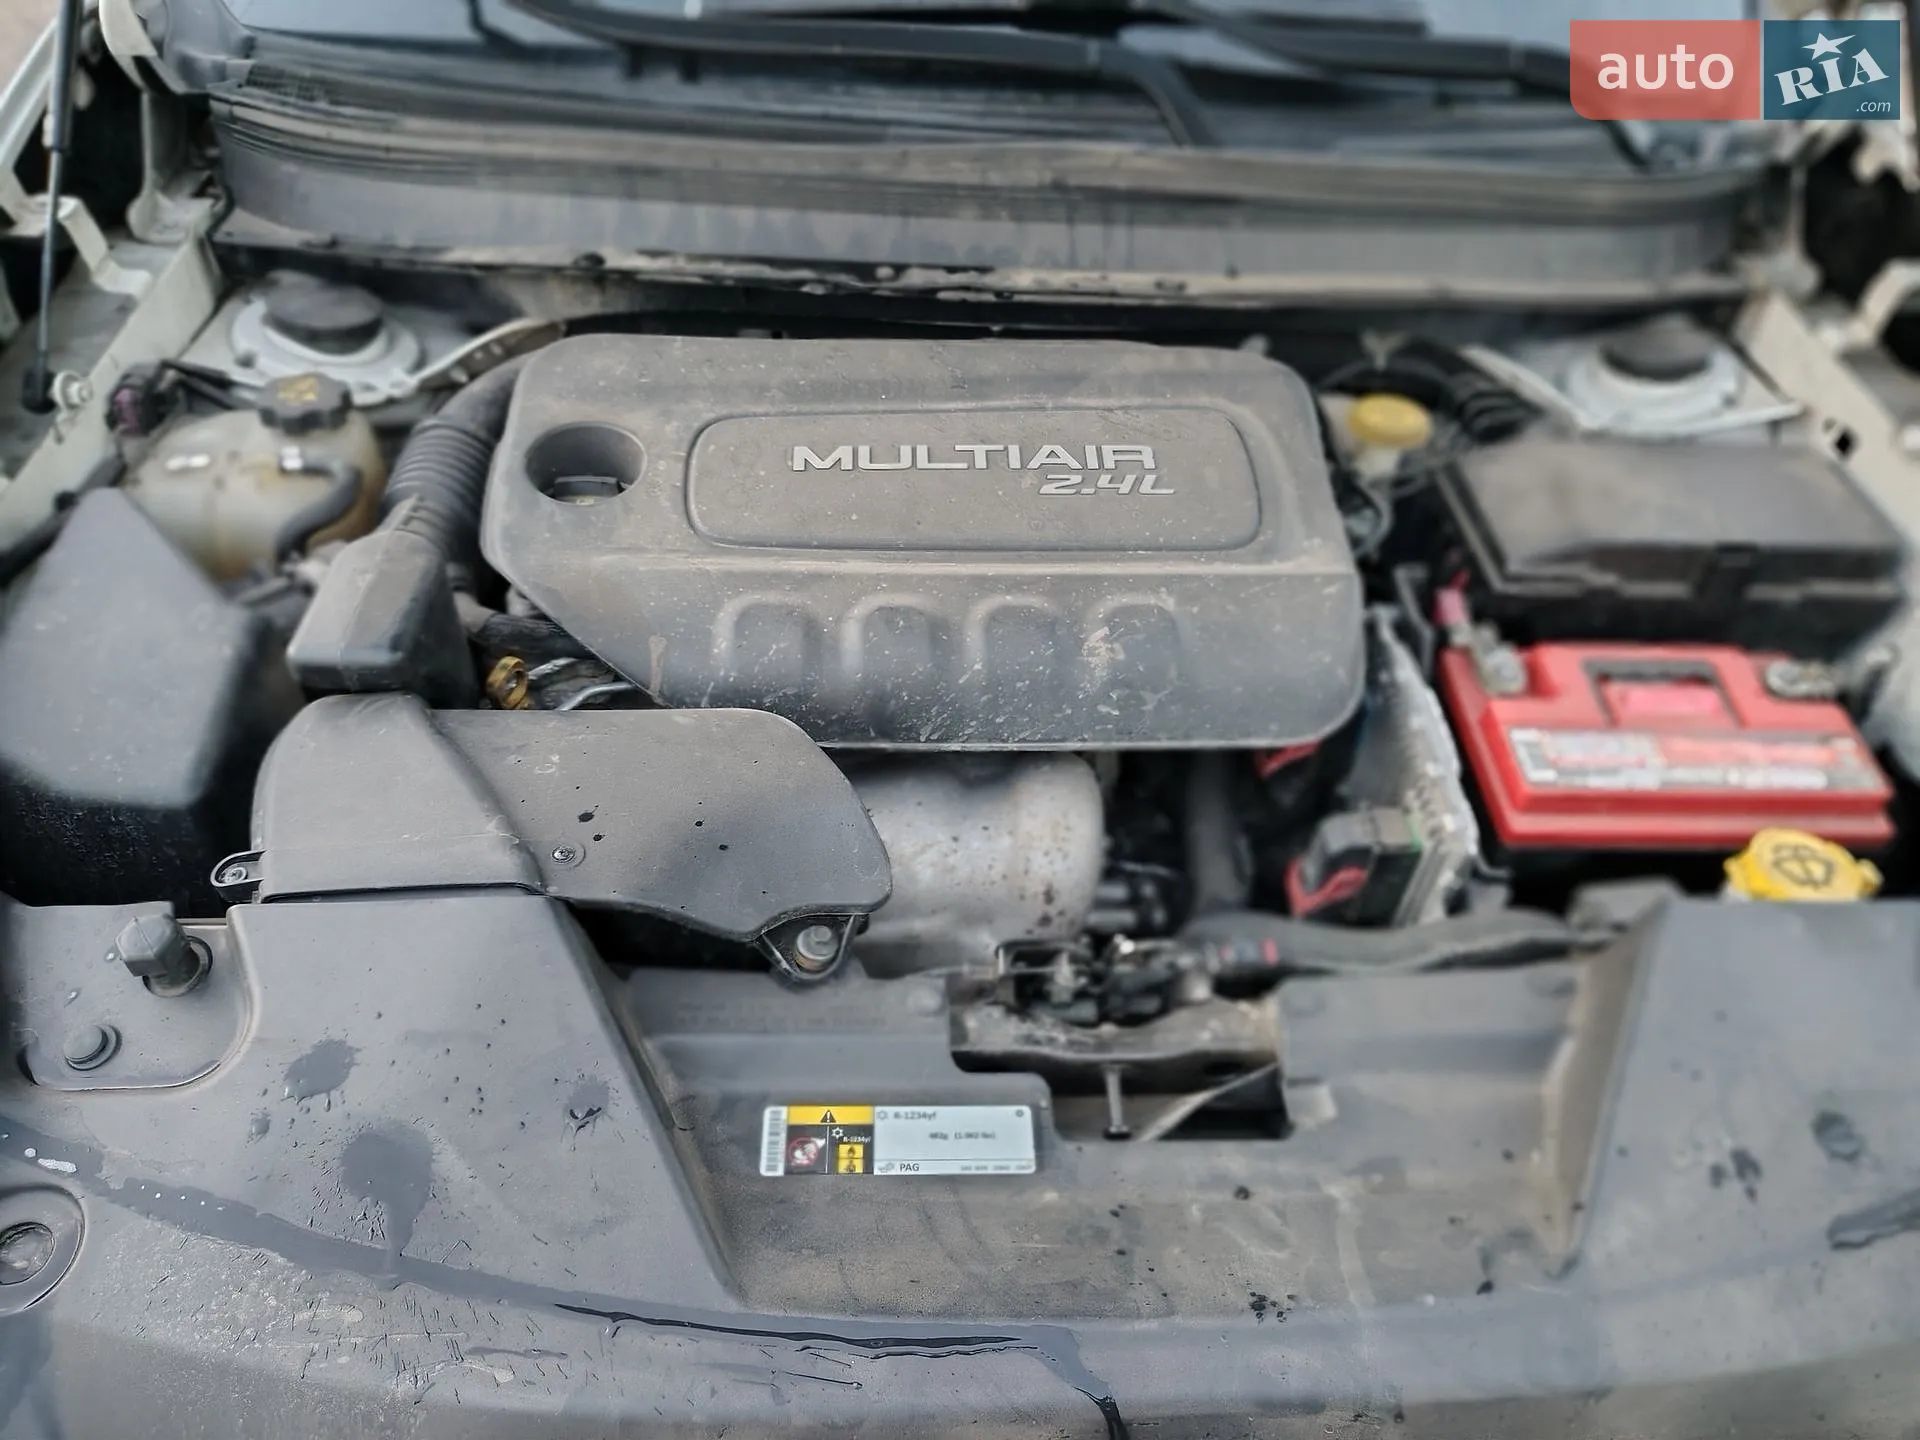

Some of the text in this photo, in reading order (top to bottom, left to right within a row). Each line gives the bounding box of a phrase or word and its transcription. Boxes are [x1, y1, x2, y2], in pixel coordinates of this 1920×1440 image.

[792, 444, 1156, 471] MULTIAIR
[1038, 474, 1176, 495] 2.4L
[899, 1162, 920, 1172] PAG
